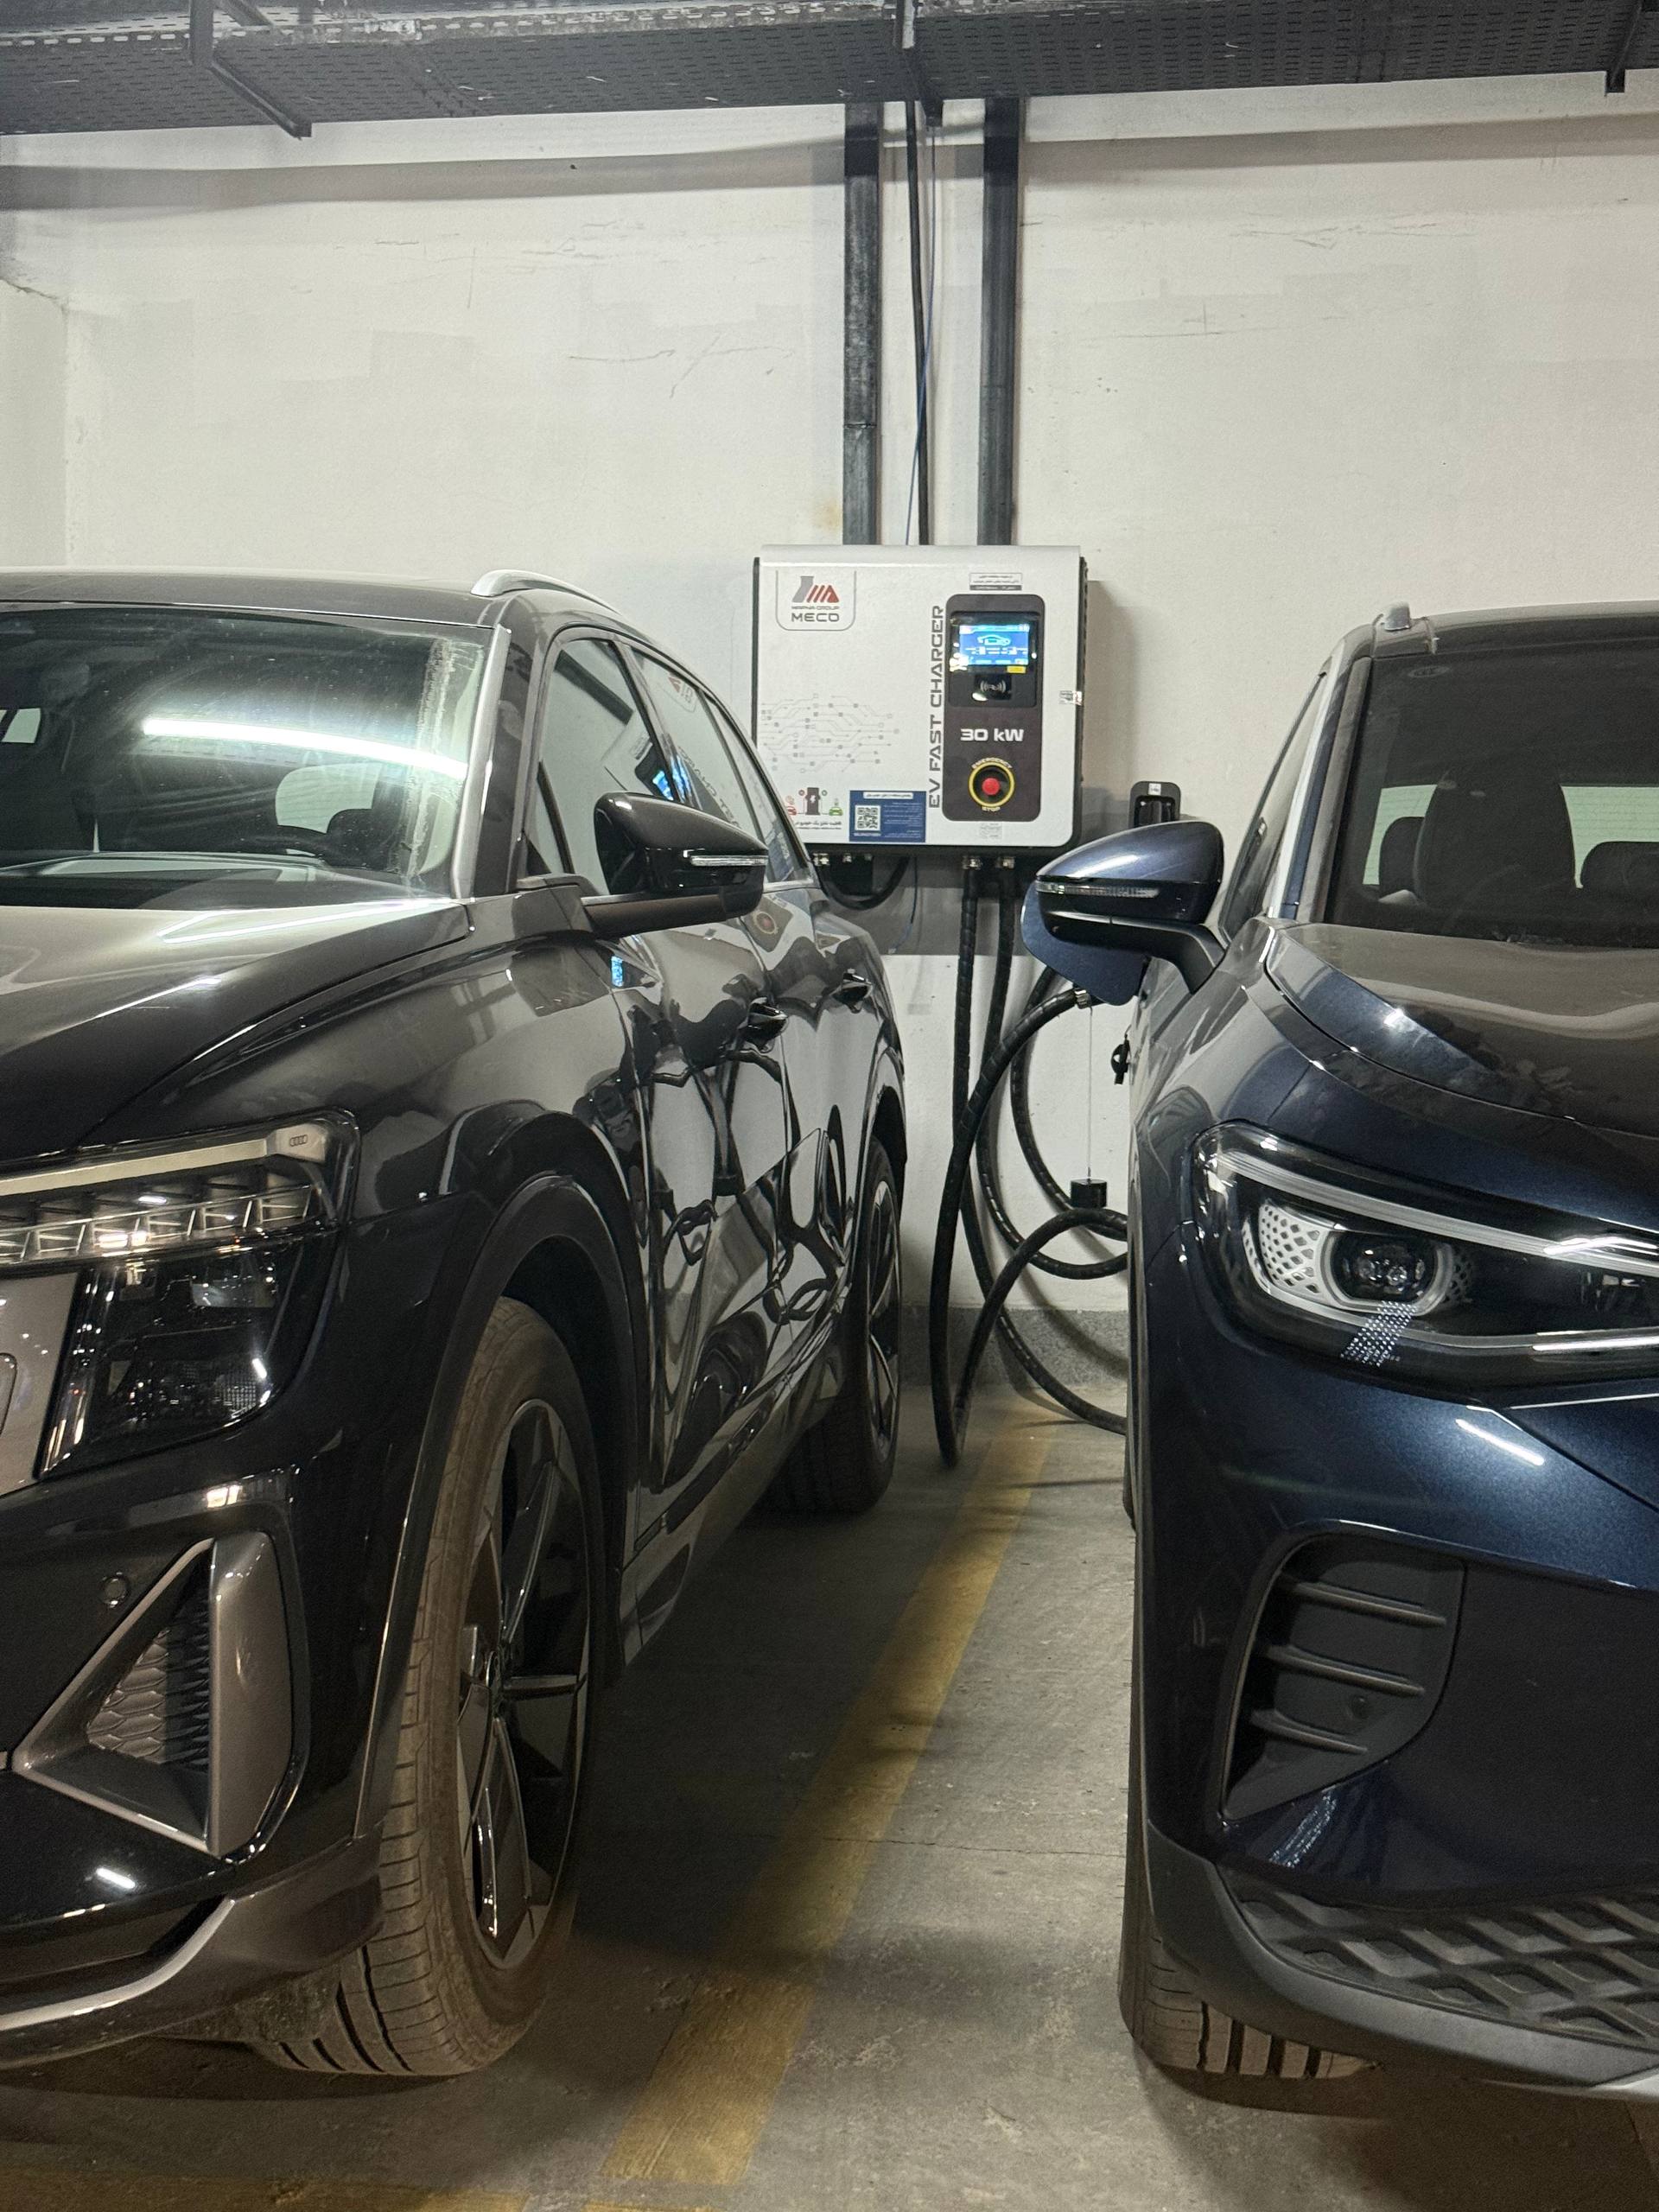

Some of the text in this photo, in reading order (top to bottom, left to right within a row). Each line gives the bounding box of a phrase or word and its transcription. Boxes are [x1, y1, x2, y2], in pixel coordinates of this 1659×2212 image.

[791, 613, 840, 622] MECO
[929, 606, 944, 809] EV FAST CHARGER
[960, 728, 1024, 741] 30 kW
